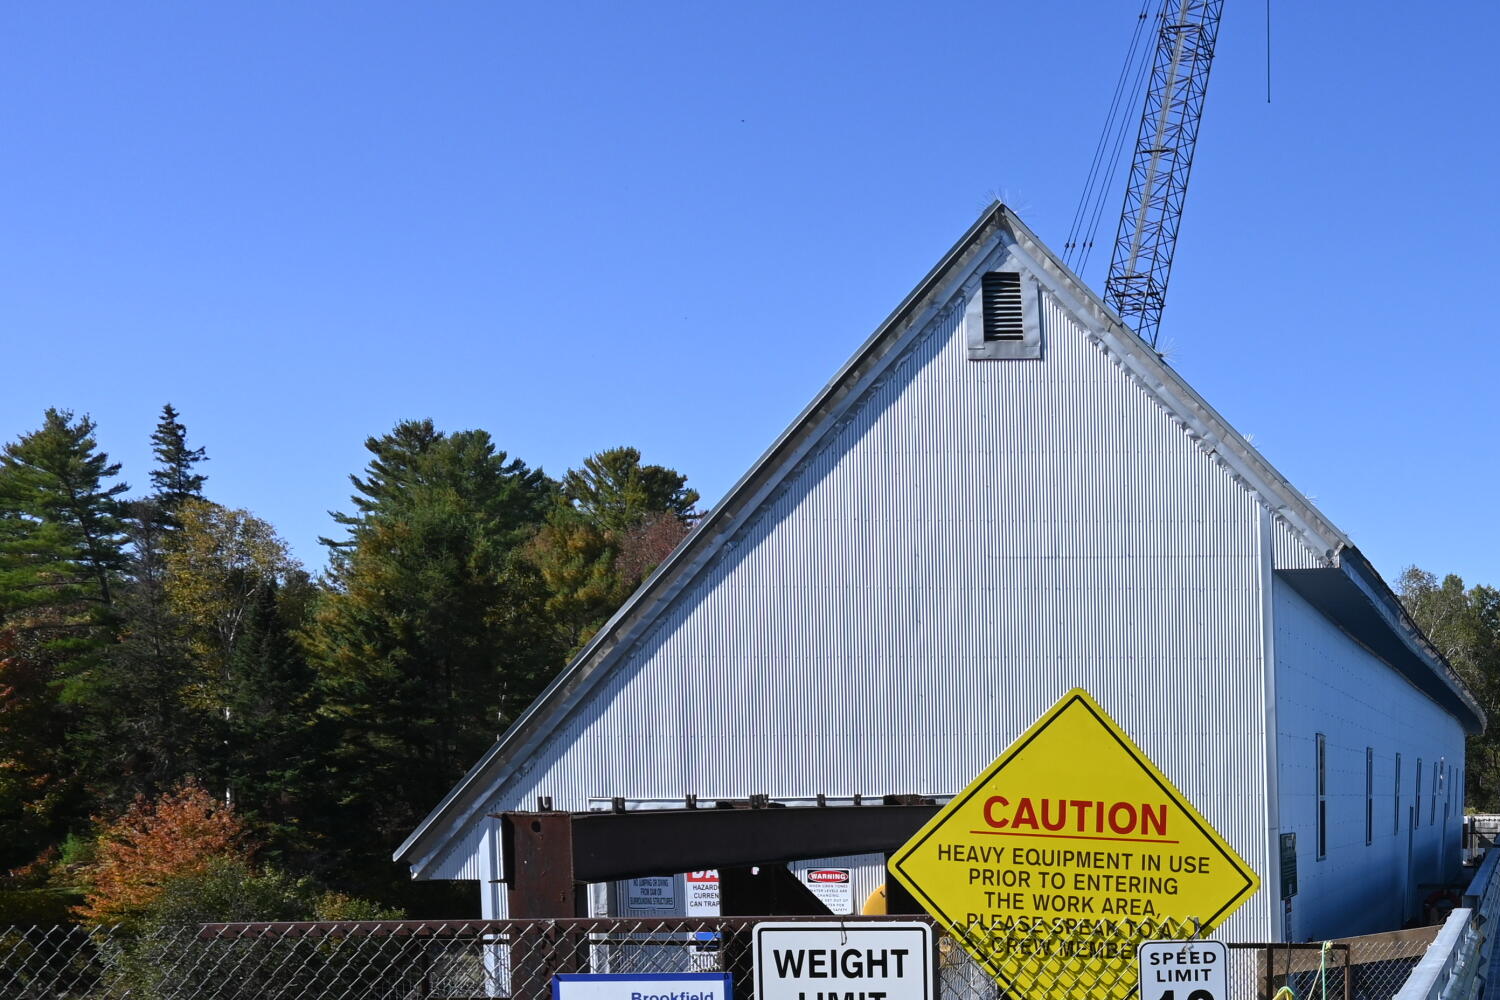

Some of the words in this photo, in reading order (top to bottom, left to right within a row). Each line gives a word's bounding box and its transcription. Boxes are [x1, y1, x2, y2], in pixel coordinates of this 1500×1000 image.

[983, 795, 1168, 836] CAUTION
[938, 844, 1005, 863] HEAVY
[1012, 848, 1133, 870] EQUIPMENT
[1141, 856, 1162, 871] IN
[1169, 856, 1210, 874] USE
[968, 868, 1031, 888] PRIOR
[1040, 872, 1066, 889] TO
[1074, 874, 1178, 895] ENTERING
[984, 892, 1024, 910] THE
[1033, 894, 1093, 913] WORK
[1102, 898, 1162, 920] AREA,
[967, 913, 1043, 934] PLEASE
[1052, 917, 1119, 937] SPEAK
[1126, 920, 1153, 938] TO
[1160, 923, 1173, 939] A
[992, 936, 1050, 955] CREW
[1150, 952, 1217, 966] SPEED
[773, 948, 909, 979] WEIGHT
[1157, 969, 1212, 982] LIMIT
